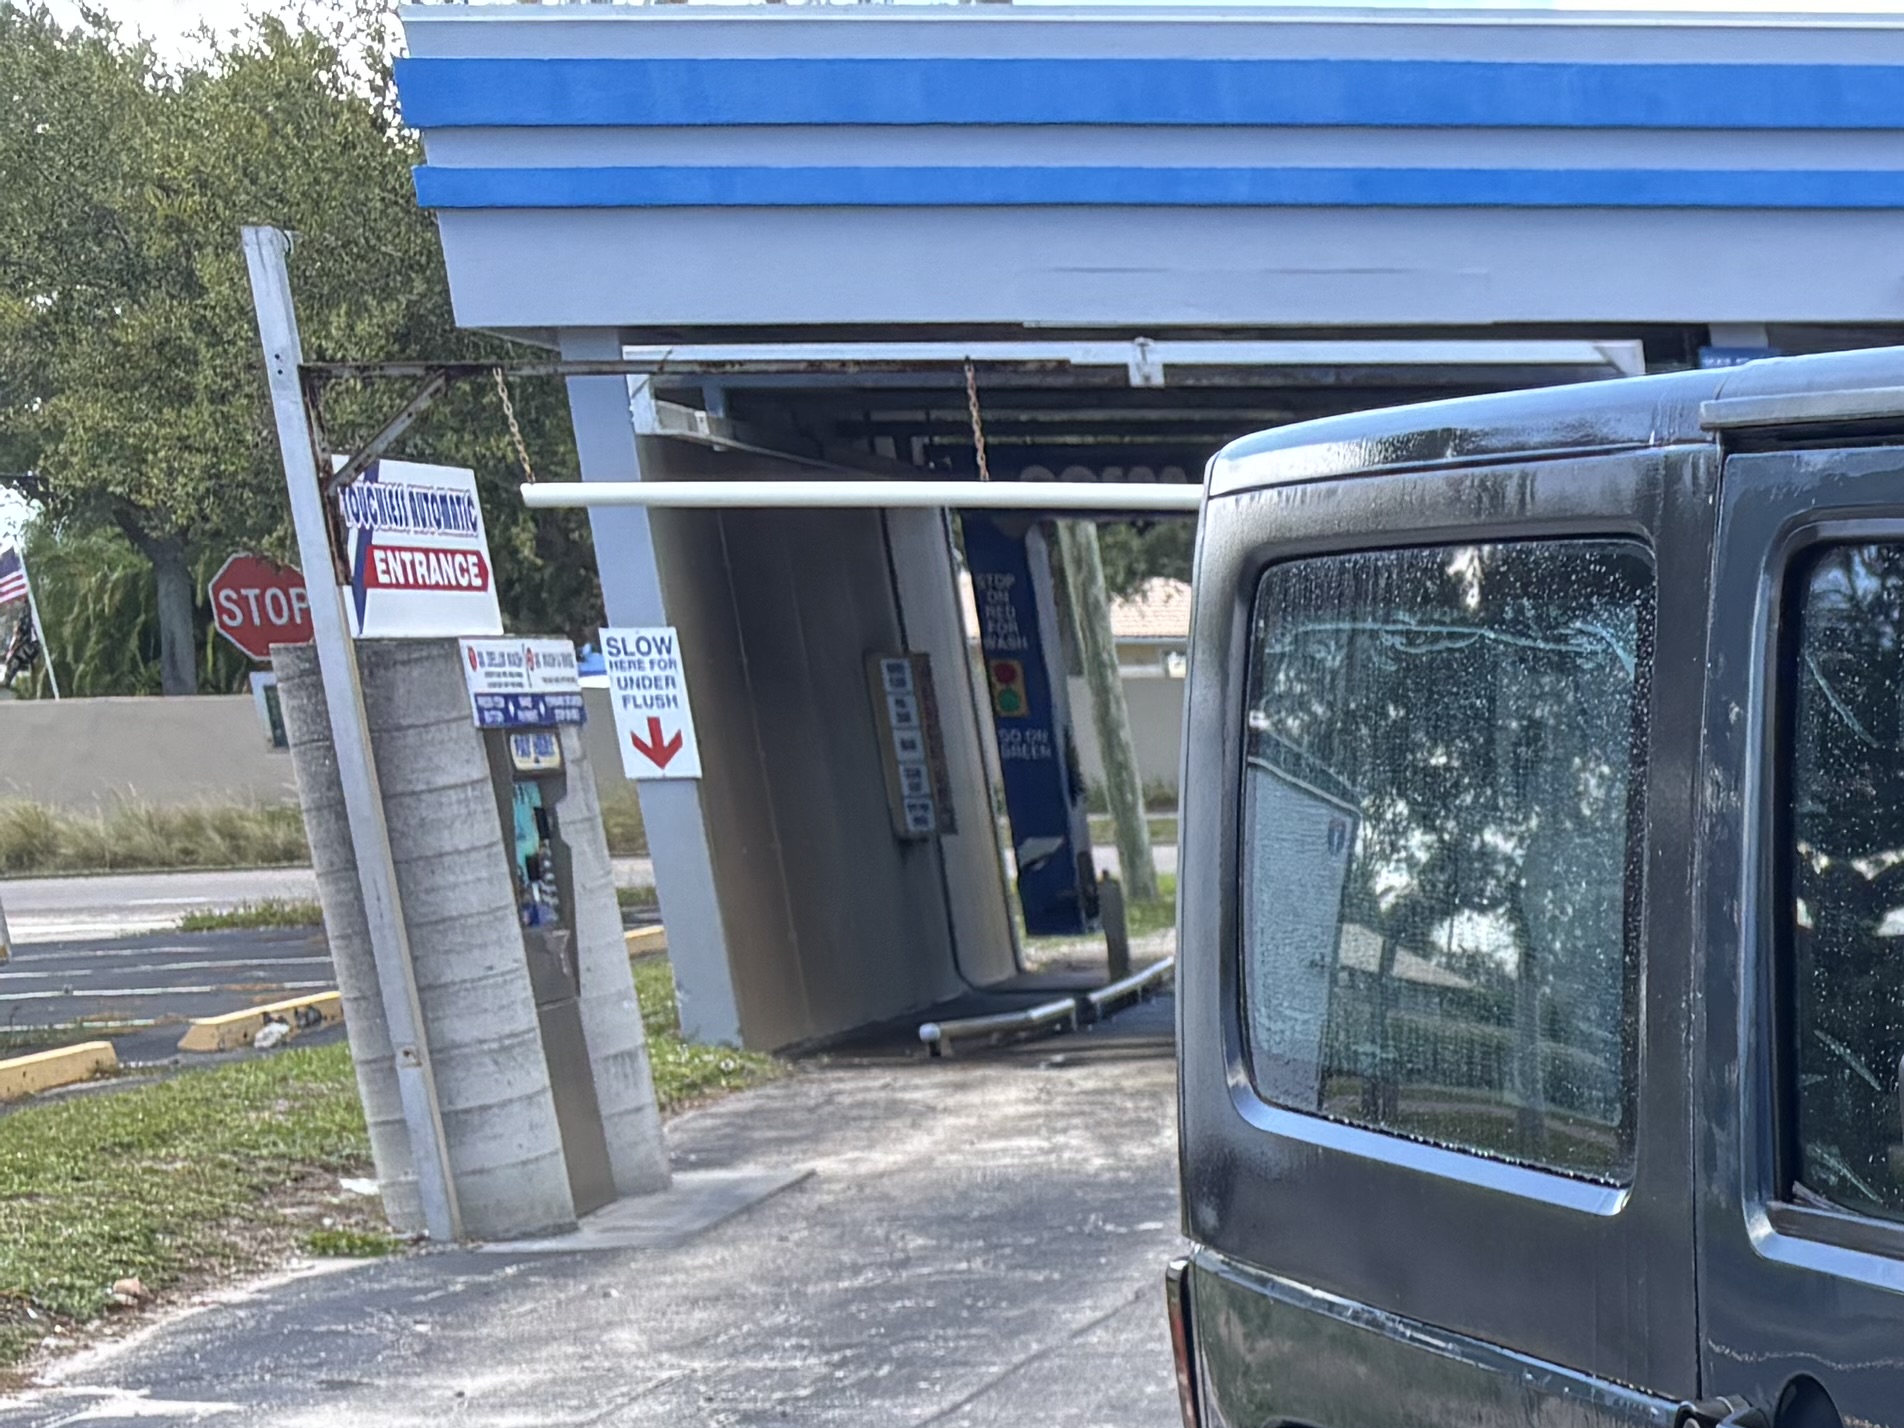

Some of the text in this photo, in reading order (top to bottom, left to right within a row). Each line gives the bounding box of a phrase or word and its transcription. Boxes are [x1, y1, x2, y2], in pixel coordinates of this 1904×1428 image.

[409, 488, 478, 532] AUTOMATIC
[373, 549, 483, 587] ENTRANCE
[218, 586, 309, 628] STOP
[606, 635, 672, 657] SLOW
[609, 658, 678, 673] HERE FOR
[616, 675, 677, 691] UNDER
[622, 693, 679, 710] FLUSH
